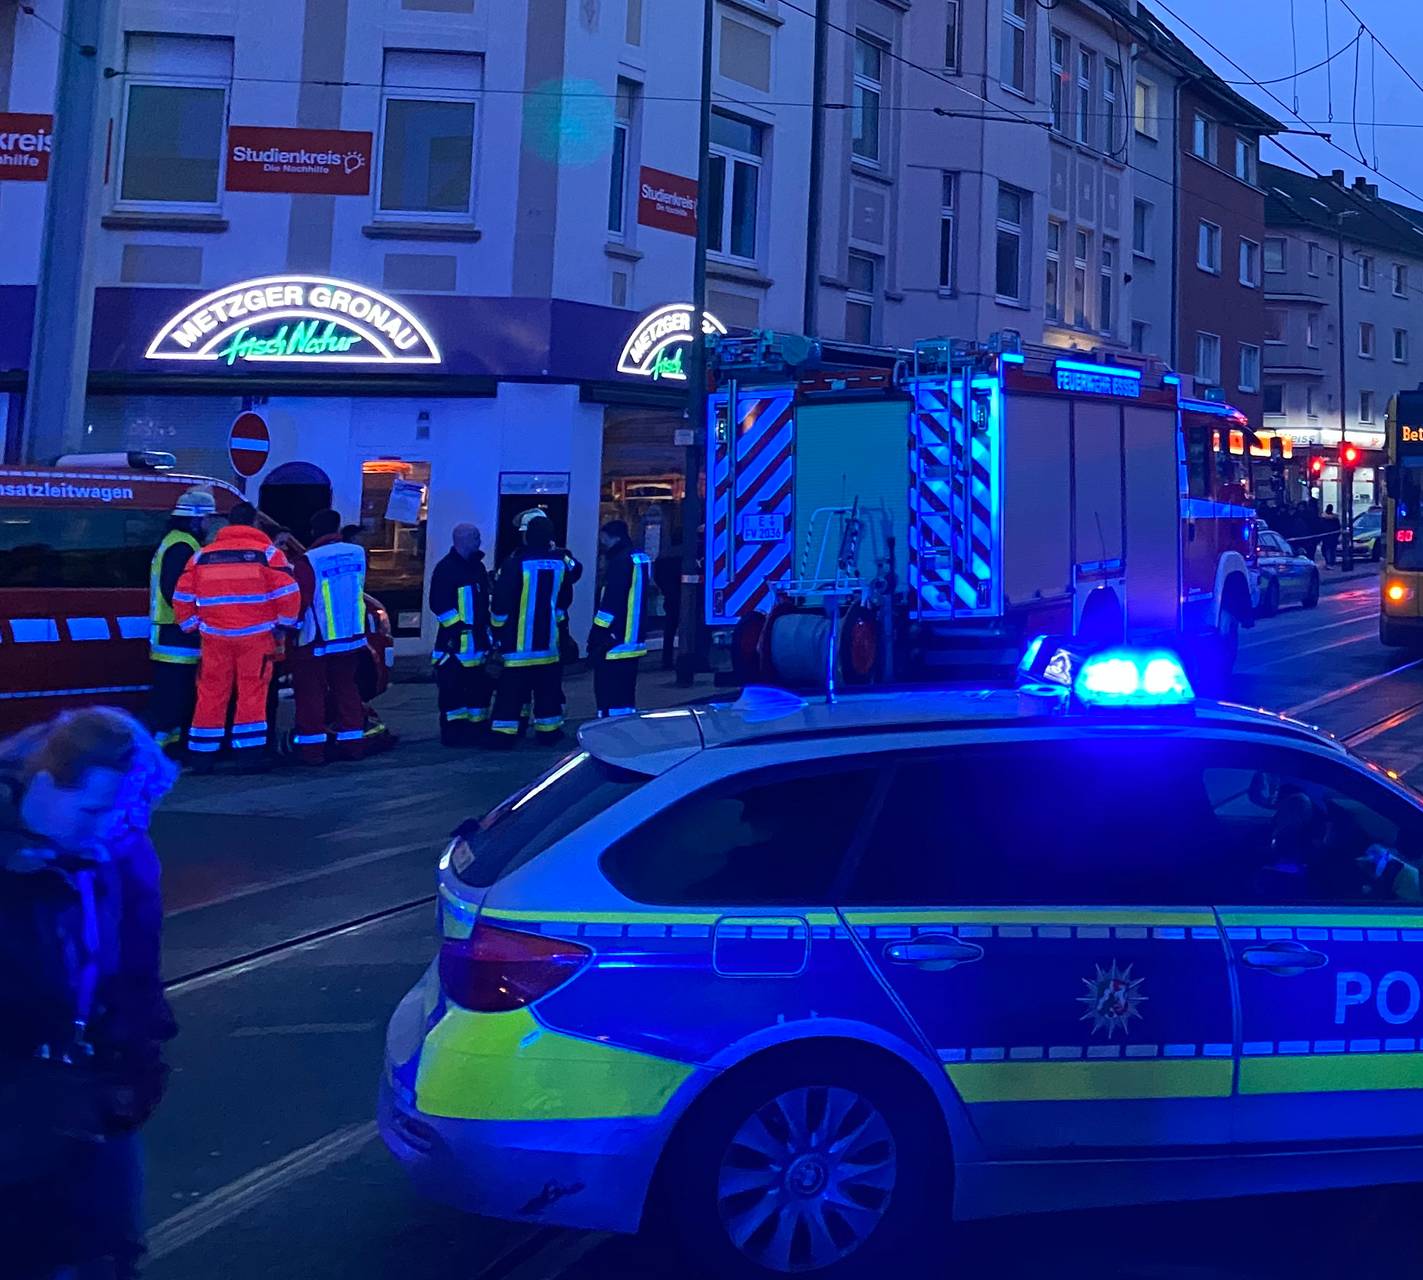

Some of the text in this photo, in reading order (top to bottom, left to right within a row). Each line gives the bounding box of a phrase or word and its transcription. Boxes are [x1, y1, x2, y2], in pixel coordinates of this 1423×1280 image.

[233, 146, 341, 165] Studienkreis
[283, 164, 329, 175] Nachhilfe
[641, 184, 694, 210] Studienkreis
[171, 285, 418, 350] METZGER GRONAU
[286, 320, 361, 356] Natur
[629, 313, 691, 364] METZGER
[1057, 370, 1111, 394] FEUERWEHR
